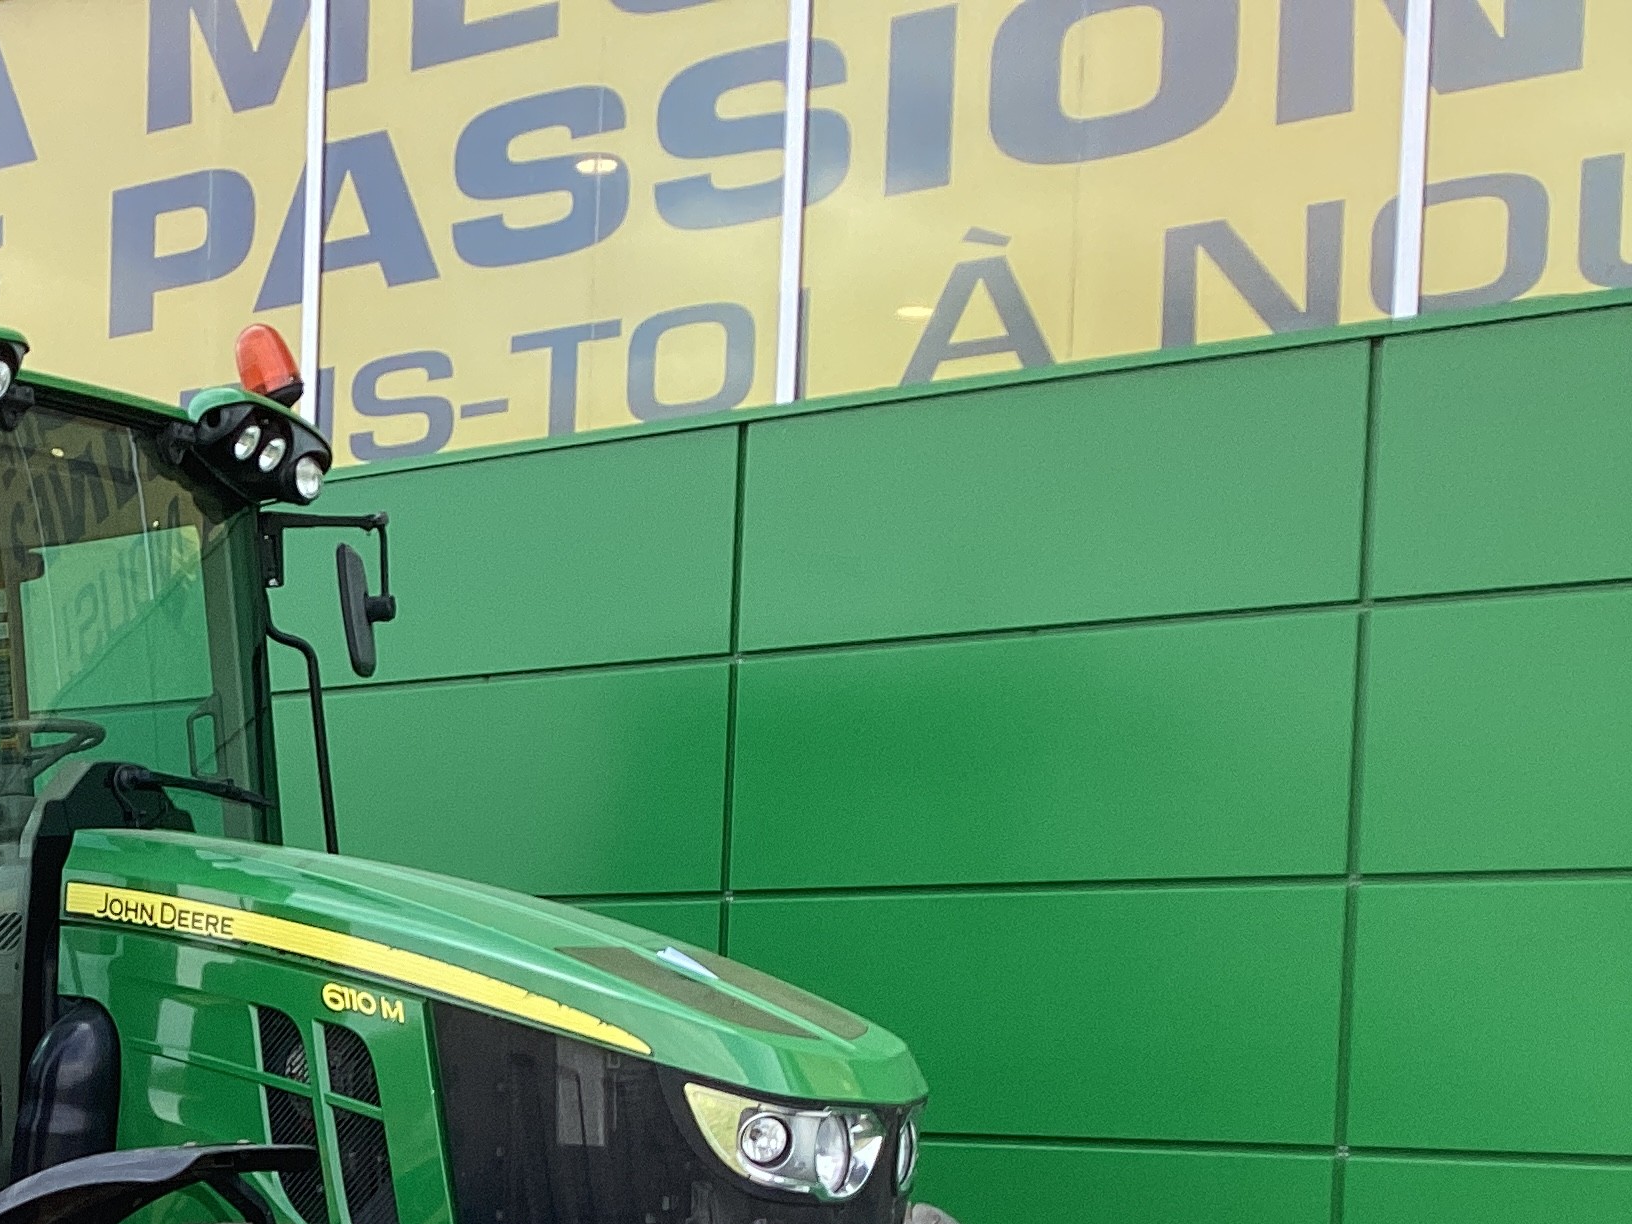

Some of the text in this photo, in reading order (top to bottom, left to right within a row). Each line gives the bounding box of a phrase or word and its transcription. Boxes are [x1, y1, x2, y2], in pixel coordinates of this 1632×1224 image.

[896, 228, 1058, 386] À
[96, 893, 234, 935] JOHN DEERE
